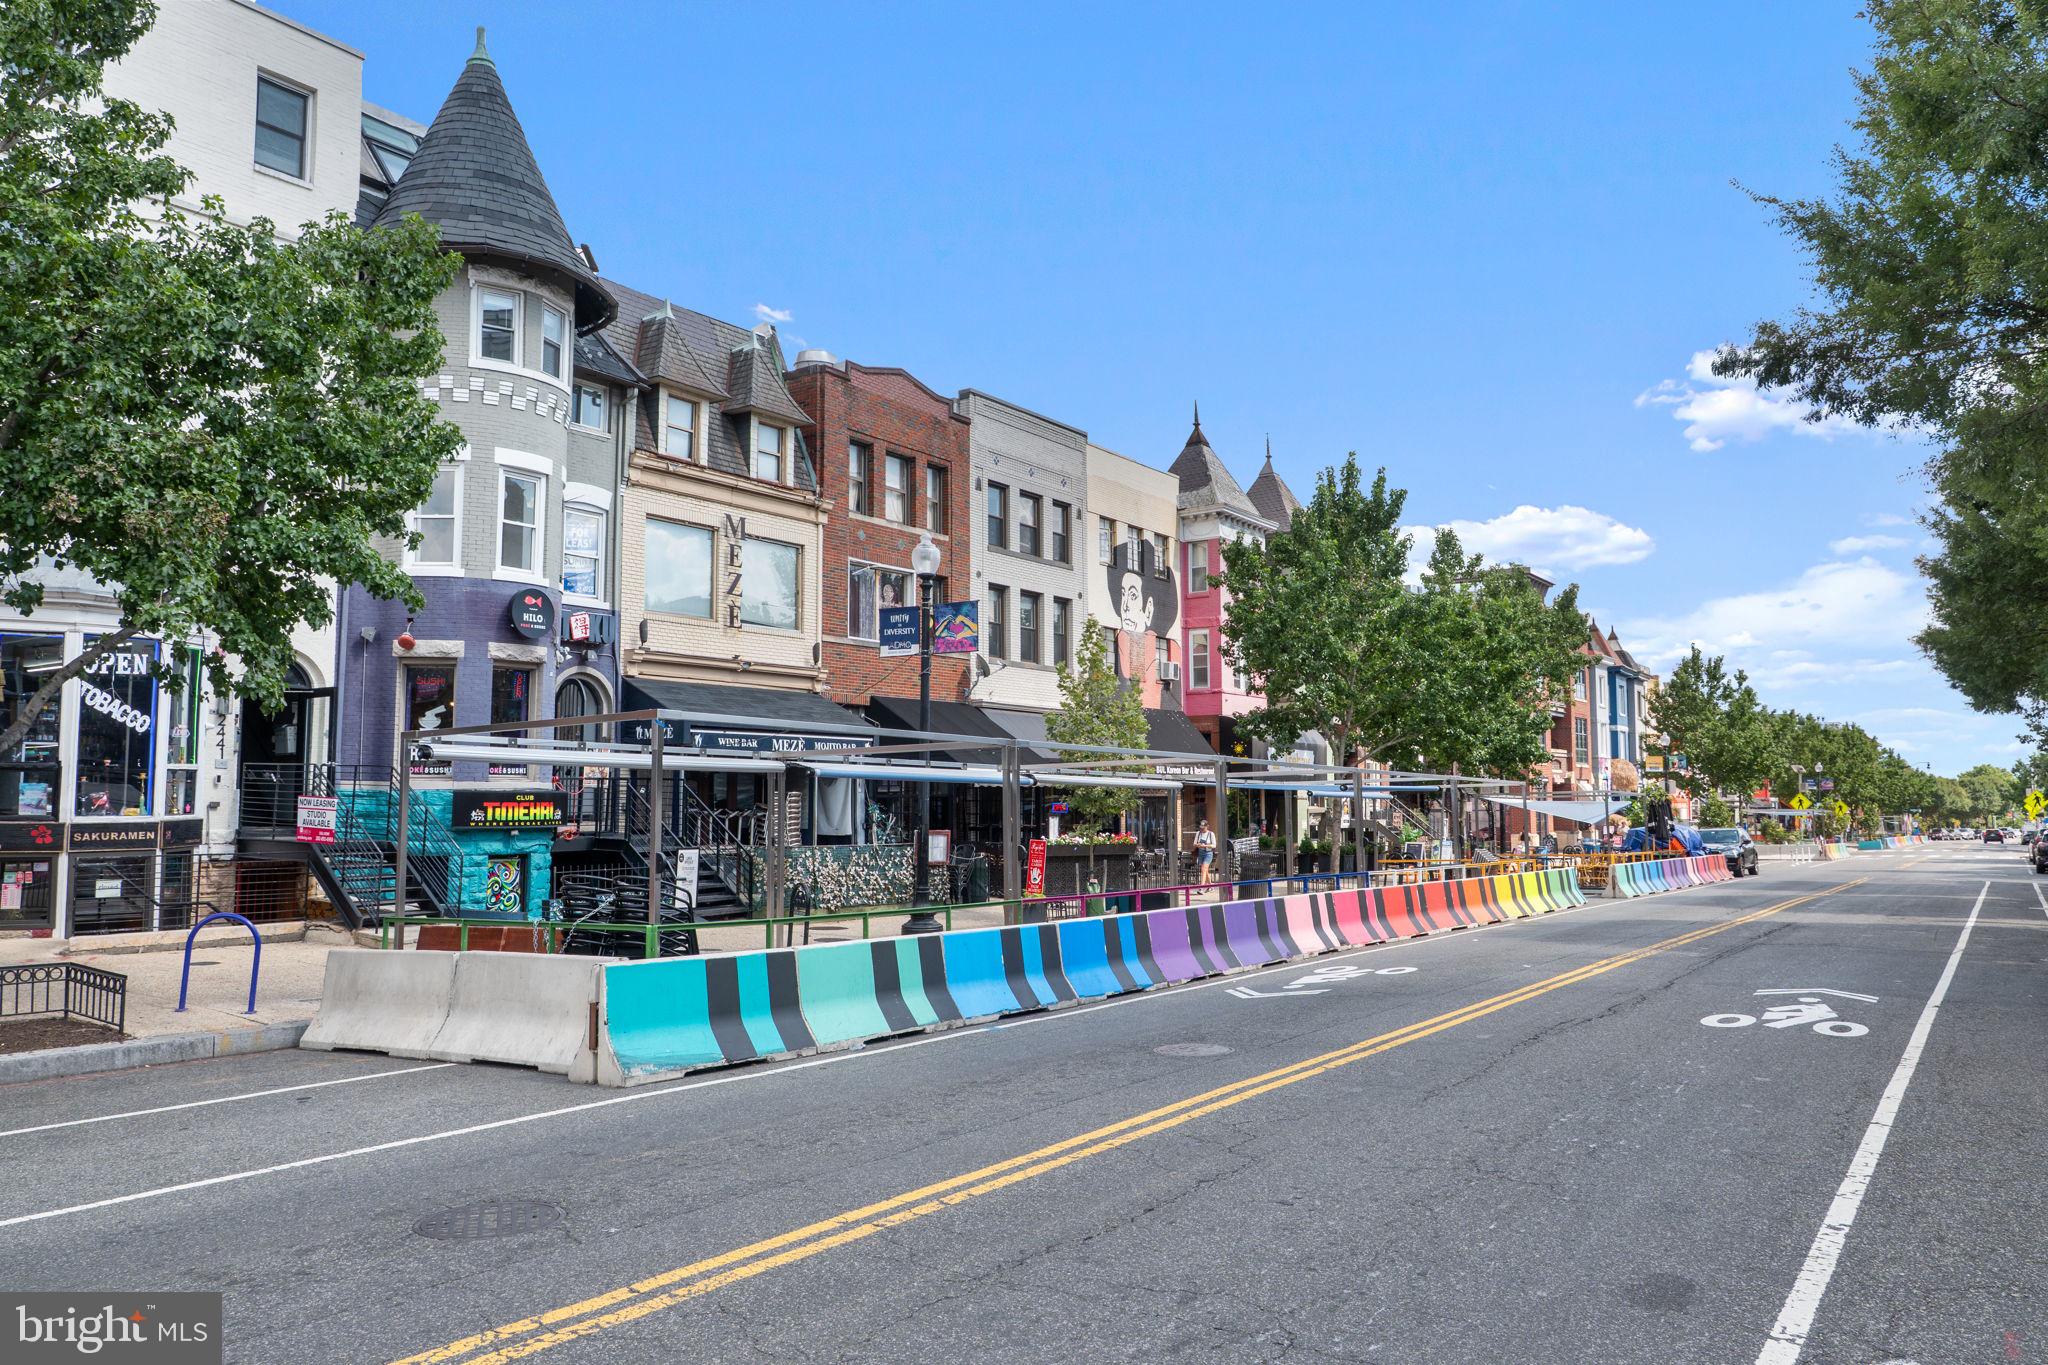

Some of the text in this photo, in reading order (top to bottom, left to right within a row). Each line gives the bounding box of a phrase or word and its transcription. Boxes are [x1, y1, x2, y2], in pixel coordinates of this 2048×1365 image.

[523, 613, 544, 623] HILO
[884, 627, 916, 636] DIVERSITY
[416, 675, 446, 685] SUSHI
[80, 680, 151, 733] TOBACCO
[216, 714, 226, 759] 2441
[644, 724, 674, 740] MZÈ
[717, 737, 740, 747] WINE
[741, 738, 758, 748] BAR
[772, 737, 806, 752] MEZÈ
[814, 741, 841, 751] MOJITO
[313, 799, 336, 808] LEASING
[307, 811, 327, 819] STUDIO
[302, 818, 331, 828] AVAILABLE
[73, 831, 155, 841] SAKURAMEN
